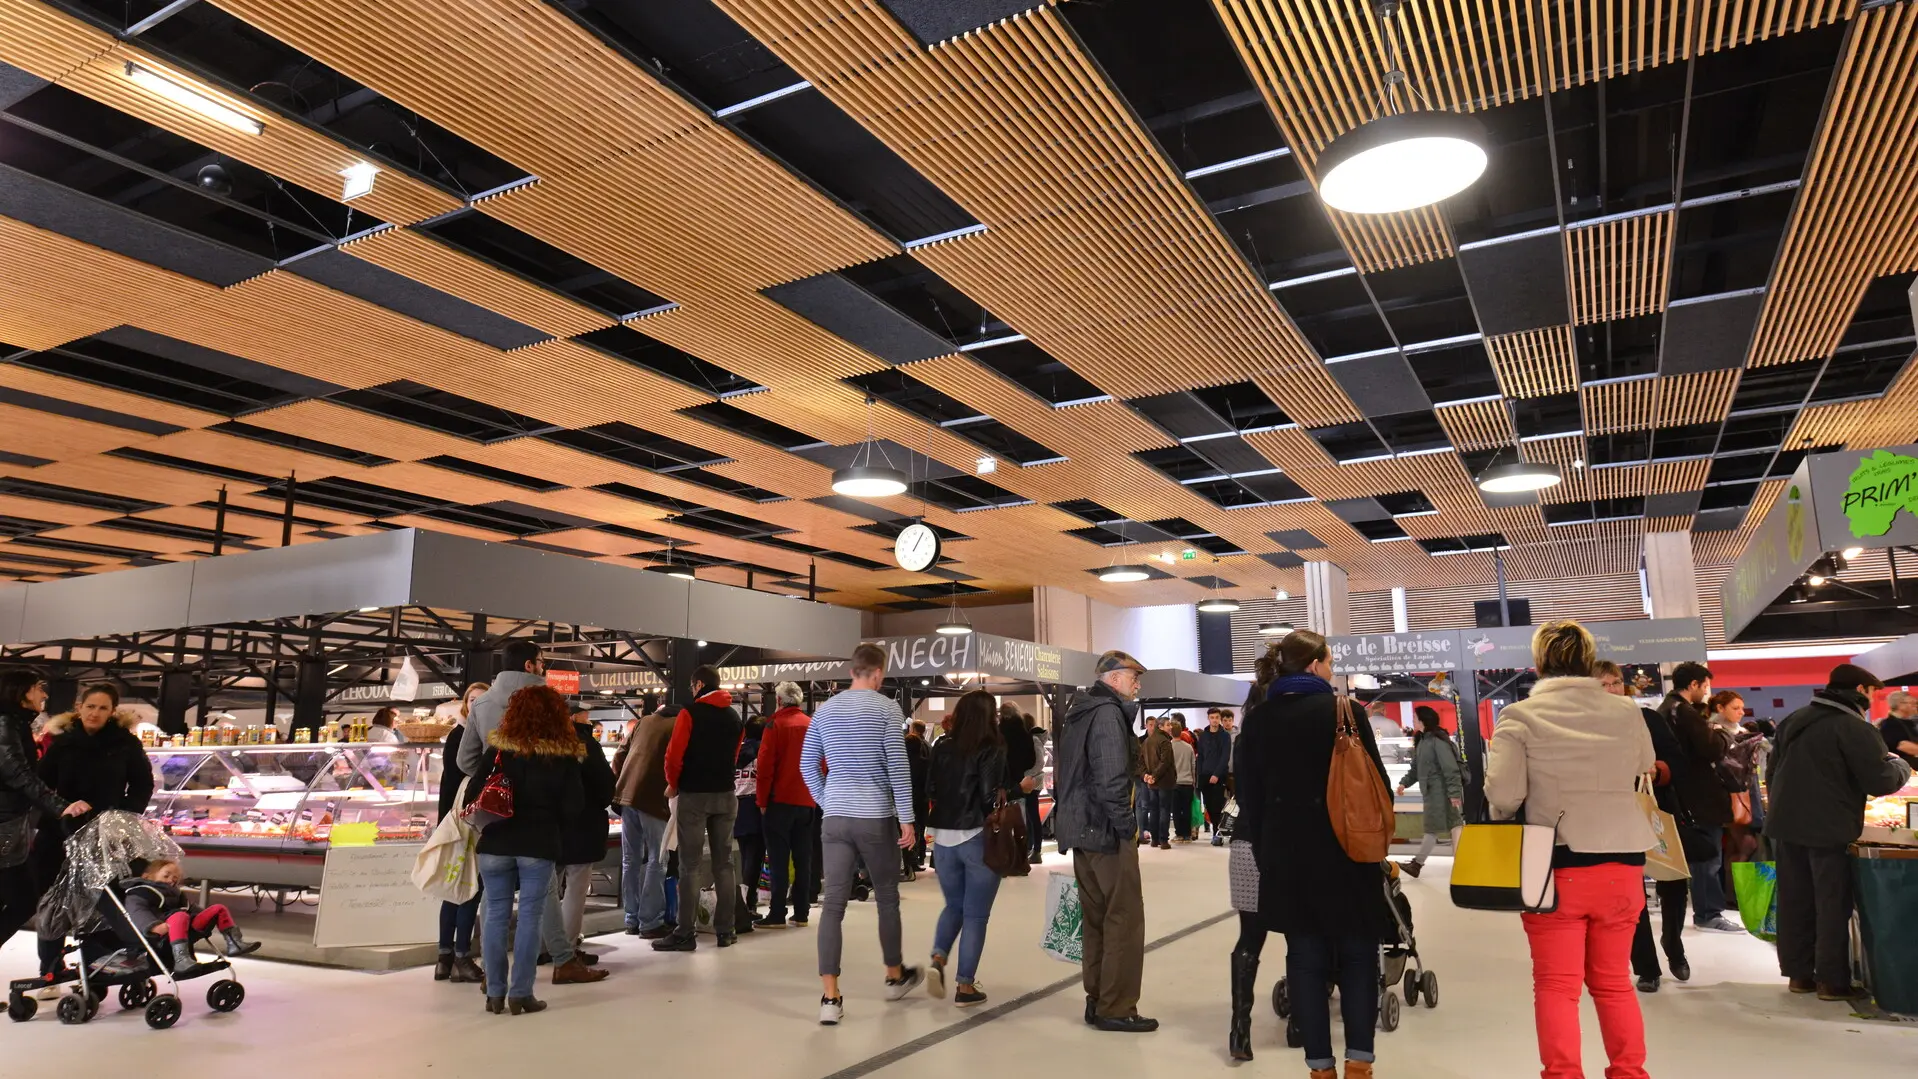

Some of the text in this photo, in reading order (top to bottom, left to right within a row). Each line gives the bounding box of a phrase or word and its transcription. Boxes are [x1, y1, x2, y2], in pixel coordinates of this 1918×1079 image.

[861, 635, 970, 673] NECH
[979, 637, 1034, 674] Maison BENECH
[1034, 646, 1061, 664] Charcuterie
[1329, 634, 1451, 661] ge de Breisse
[1413, 653, 1434, 661] Lapin
[1037, 663, 1060, 680] Salaisons
